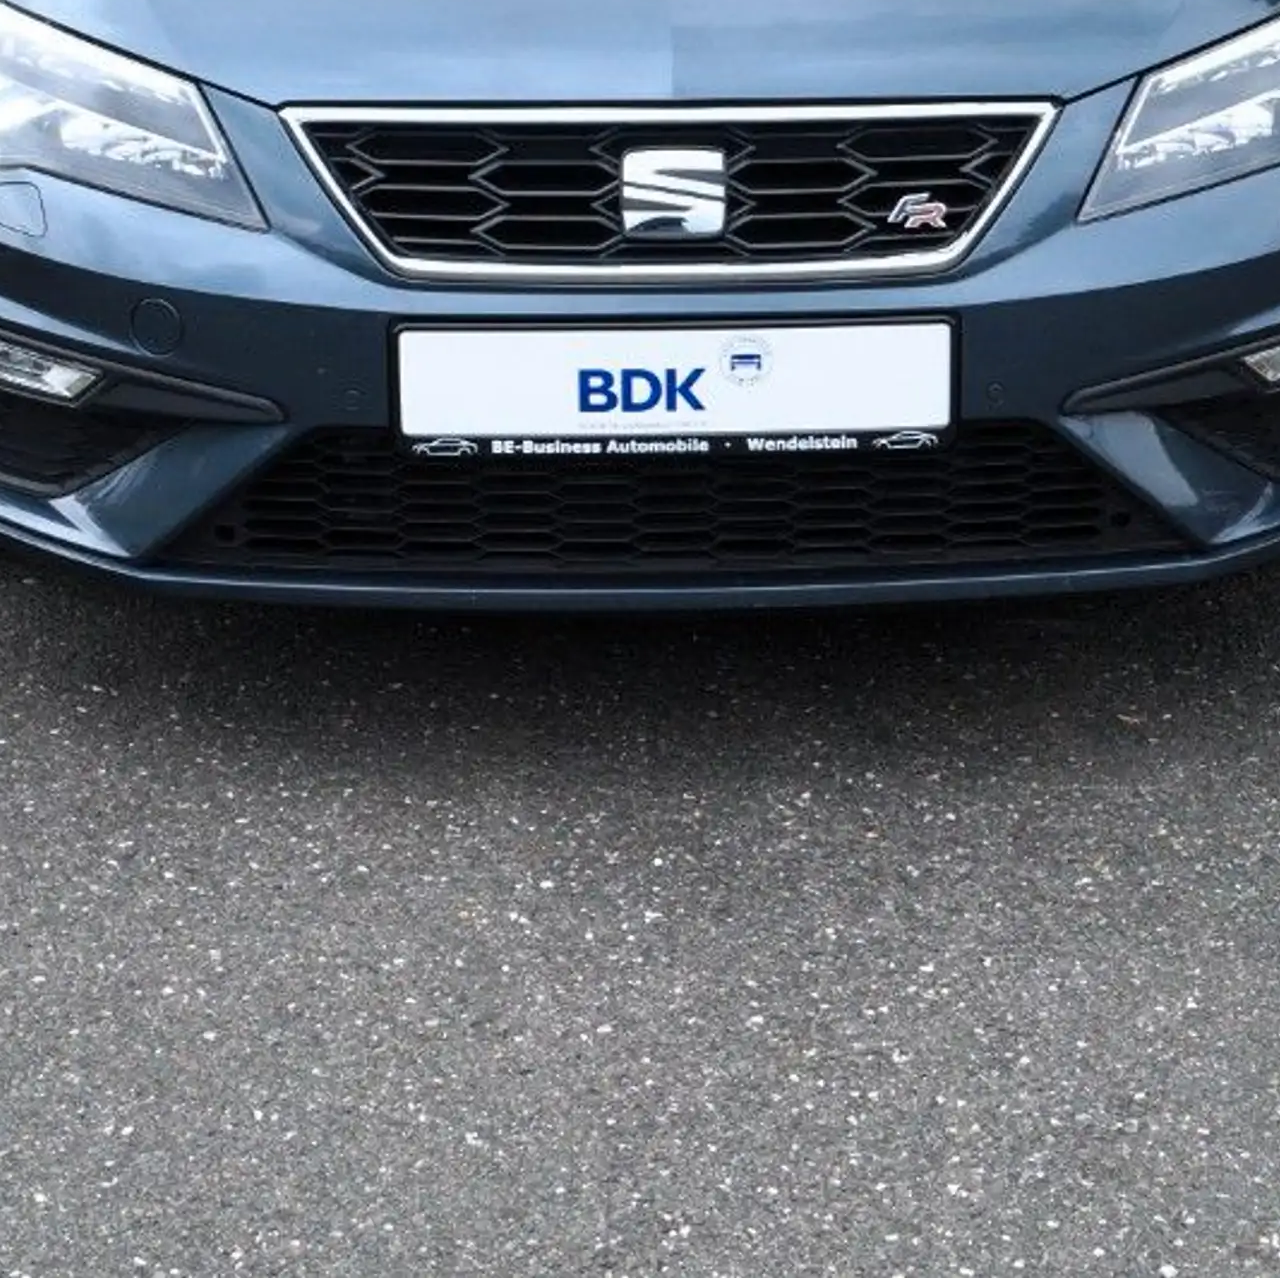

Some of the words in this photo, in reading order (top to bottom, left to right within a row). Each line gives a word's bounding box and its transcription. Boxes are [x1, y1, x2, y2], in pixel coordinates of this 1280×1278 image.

[579, 368, 706, 412] BDK
[491, 439, 602, 454] BE-Business
[606, 438, 710, 453] Automobile
[747, 435, 858, 451] Wendelstein
